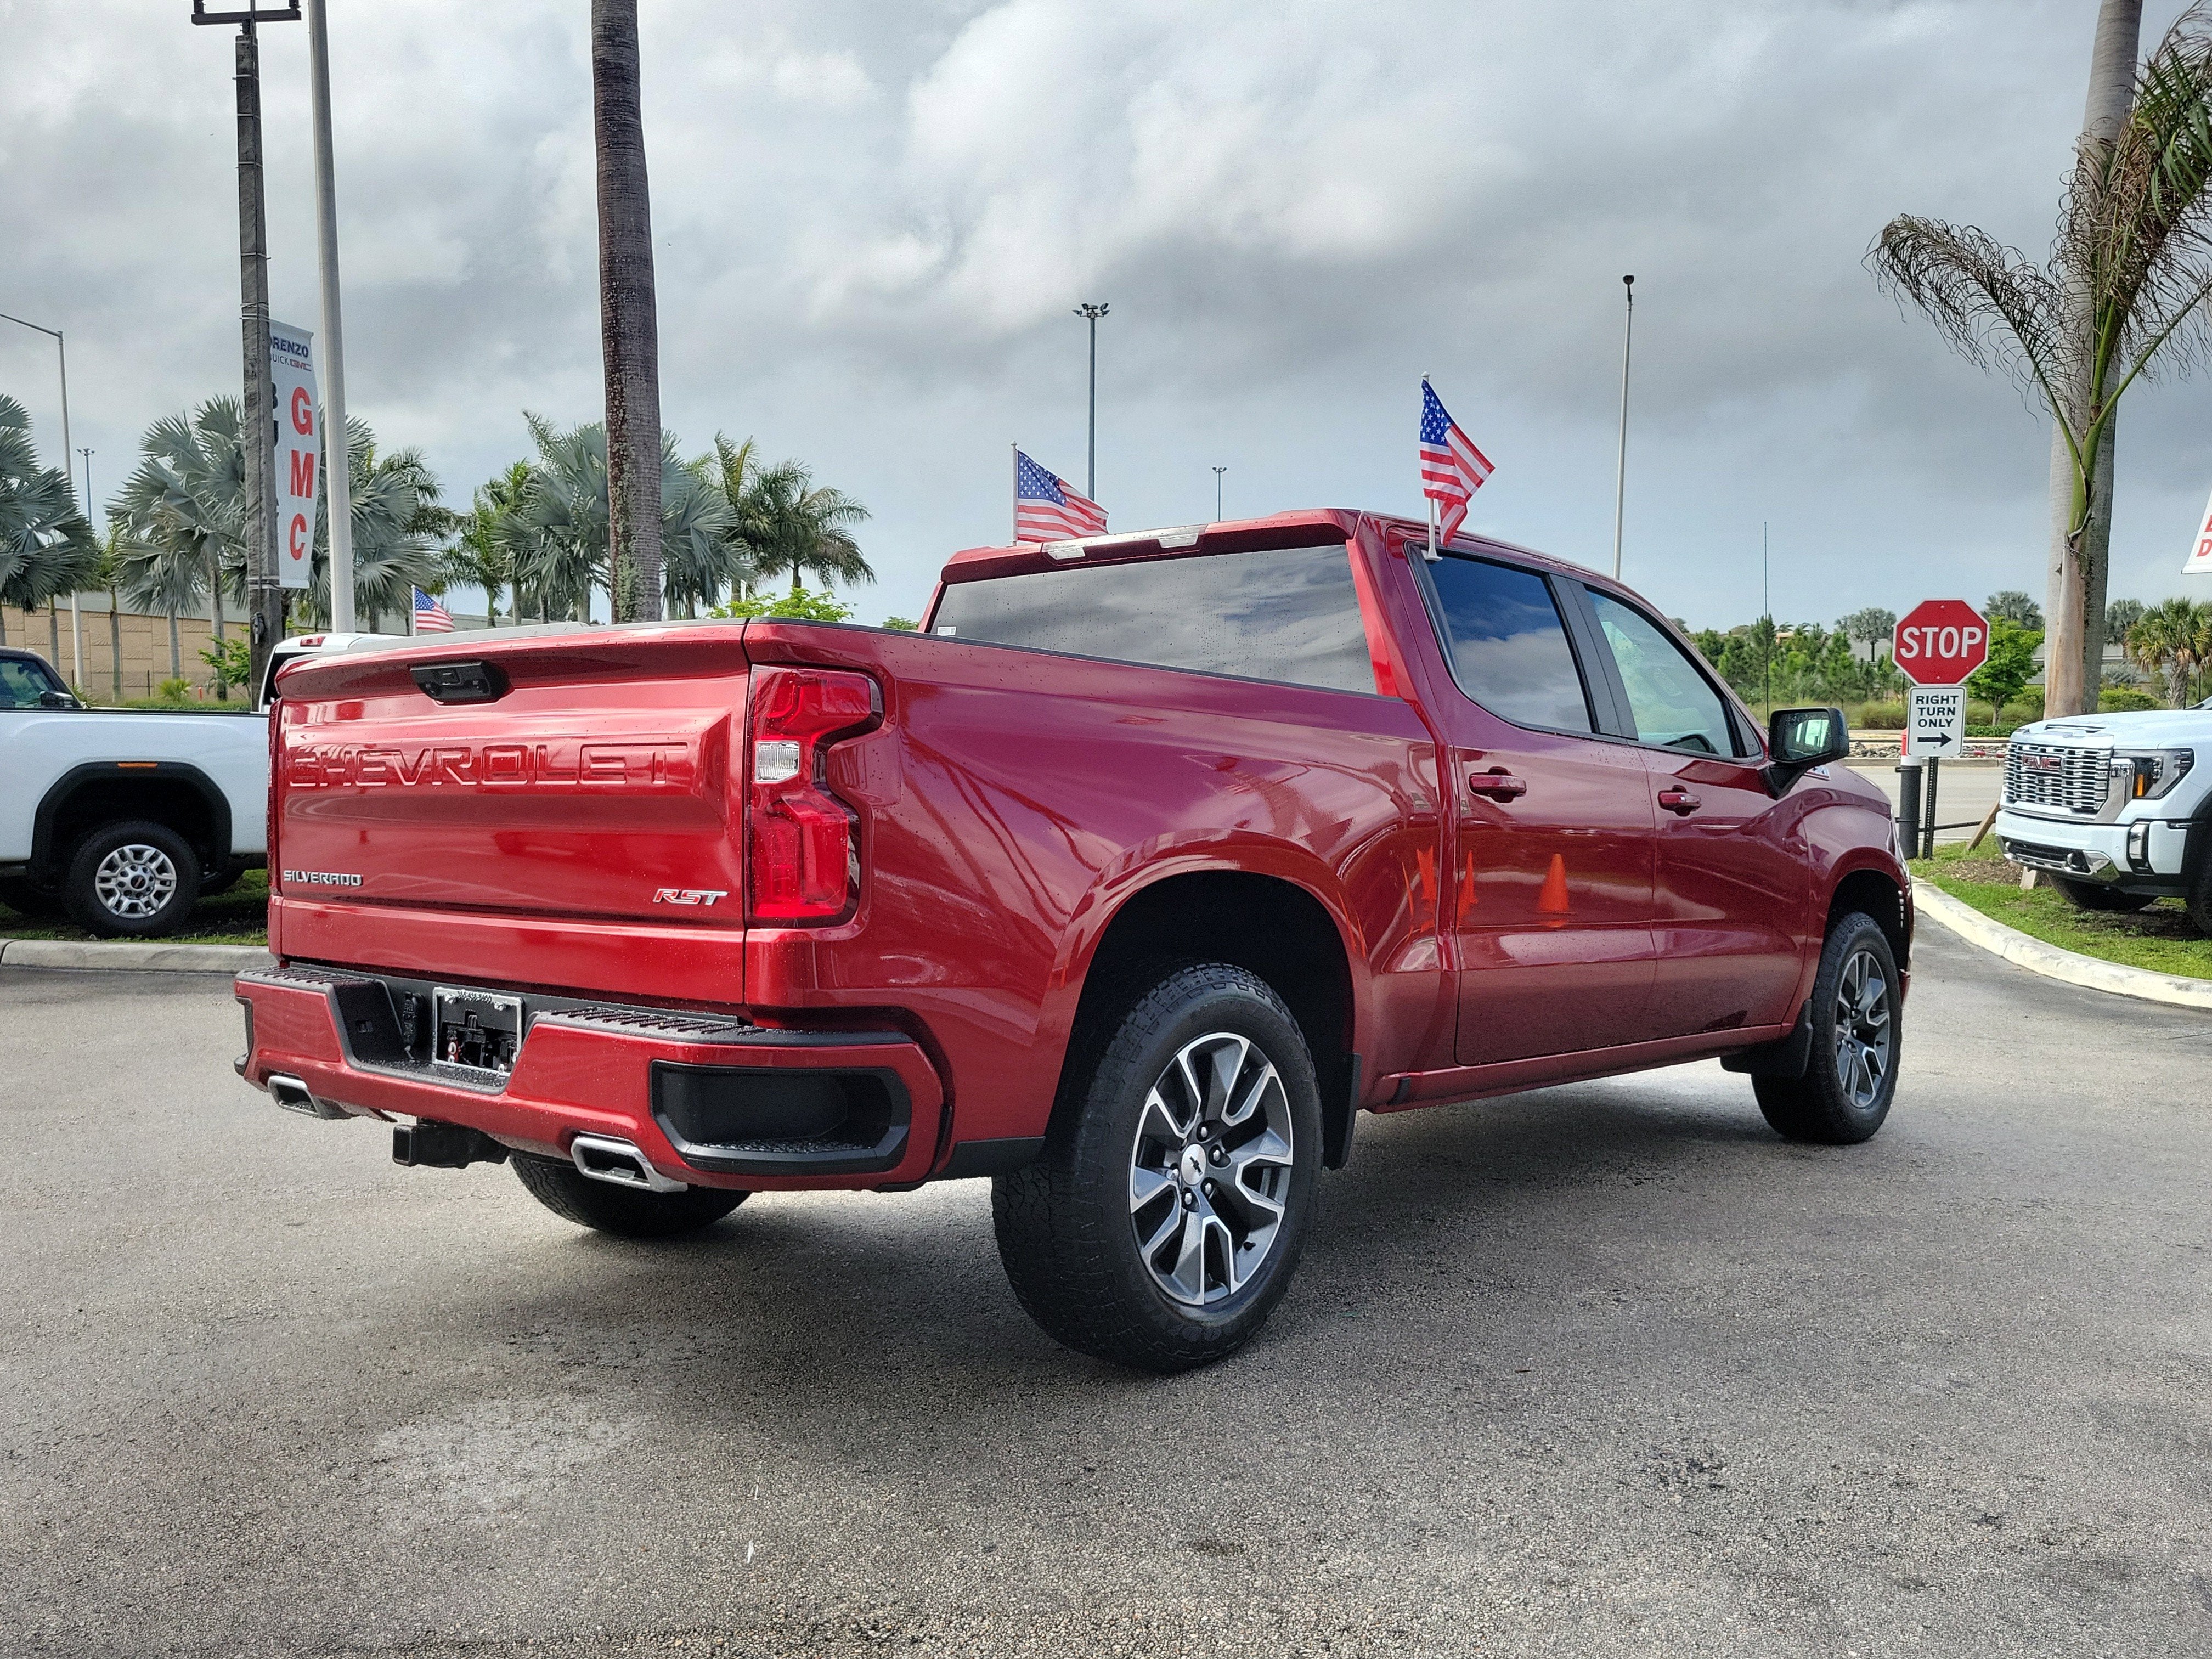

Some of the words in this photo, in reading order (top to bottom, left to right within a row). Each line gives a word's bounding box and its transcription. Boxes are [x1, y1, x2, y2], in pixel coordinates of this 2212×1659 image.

[270, 335, 309, 358] RENZO
[271, 353, 289, 365] UICK
[290, 359, 312, 372] GMC
[290, 386, 314, 561] GMC
[1899, 626, 1982, 658] STOP
[1915, 695, 1959, 705] RIGHT
[1917, 707, 1956, 716] TURN
[1917, 718, 1954, 728] ONLY
[289, 742, 689, 786] CHEVROLET
[284, 870, 364, 887] SILVERADO
[652, 888, 729, 906] RST
